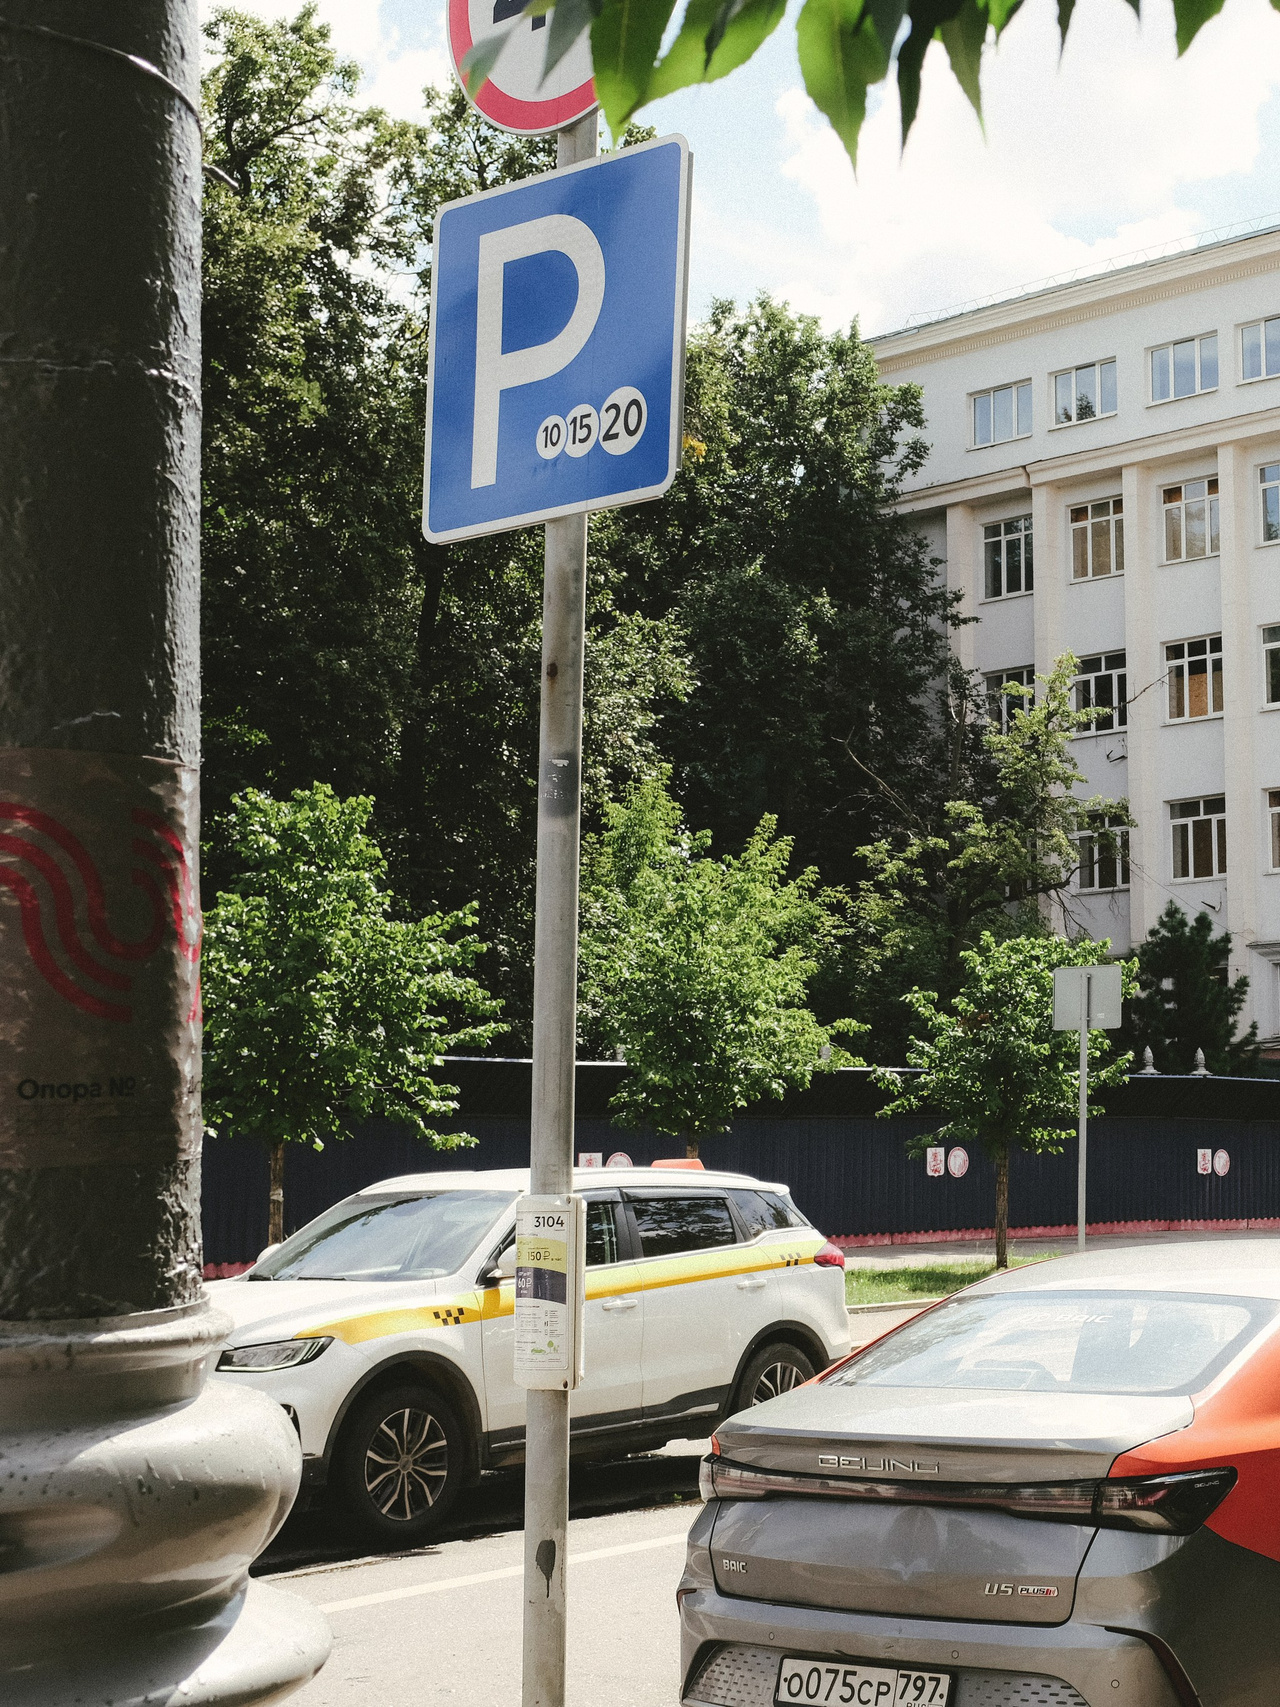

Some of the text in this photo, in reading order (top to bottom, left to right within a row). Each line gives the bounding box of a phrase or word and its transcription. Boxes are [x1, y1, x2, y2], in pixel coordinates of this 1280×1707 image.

[470, 213, 606, 490] P
[542, 398, 643, 448] 10 15 20
[17, 1078, 103, 1103] Опора
[534, 1215, 565, 1228] 3104
[527, 1251, 542, 1261] 150
[818, 1454, 940, 1474] BEIJING
[722, 1558, 748, 1574] BAIC
[984, 1582, 1046, 1596] U5 PLUS
[787, 1666, 941, 1707] О075СР 797
